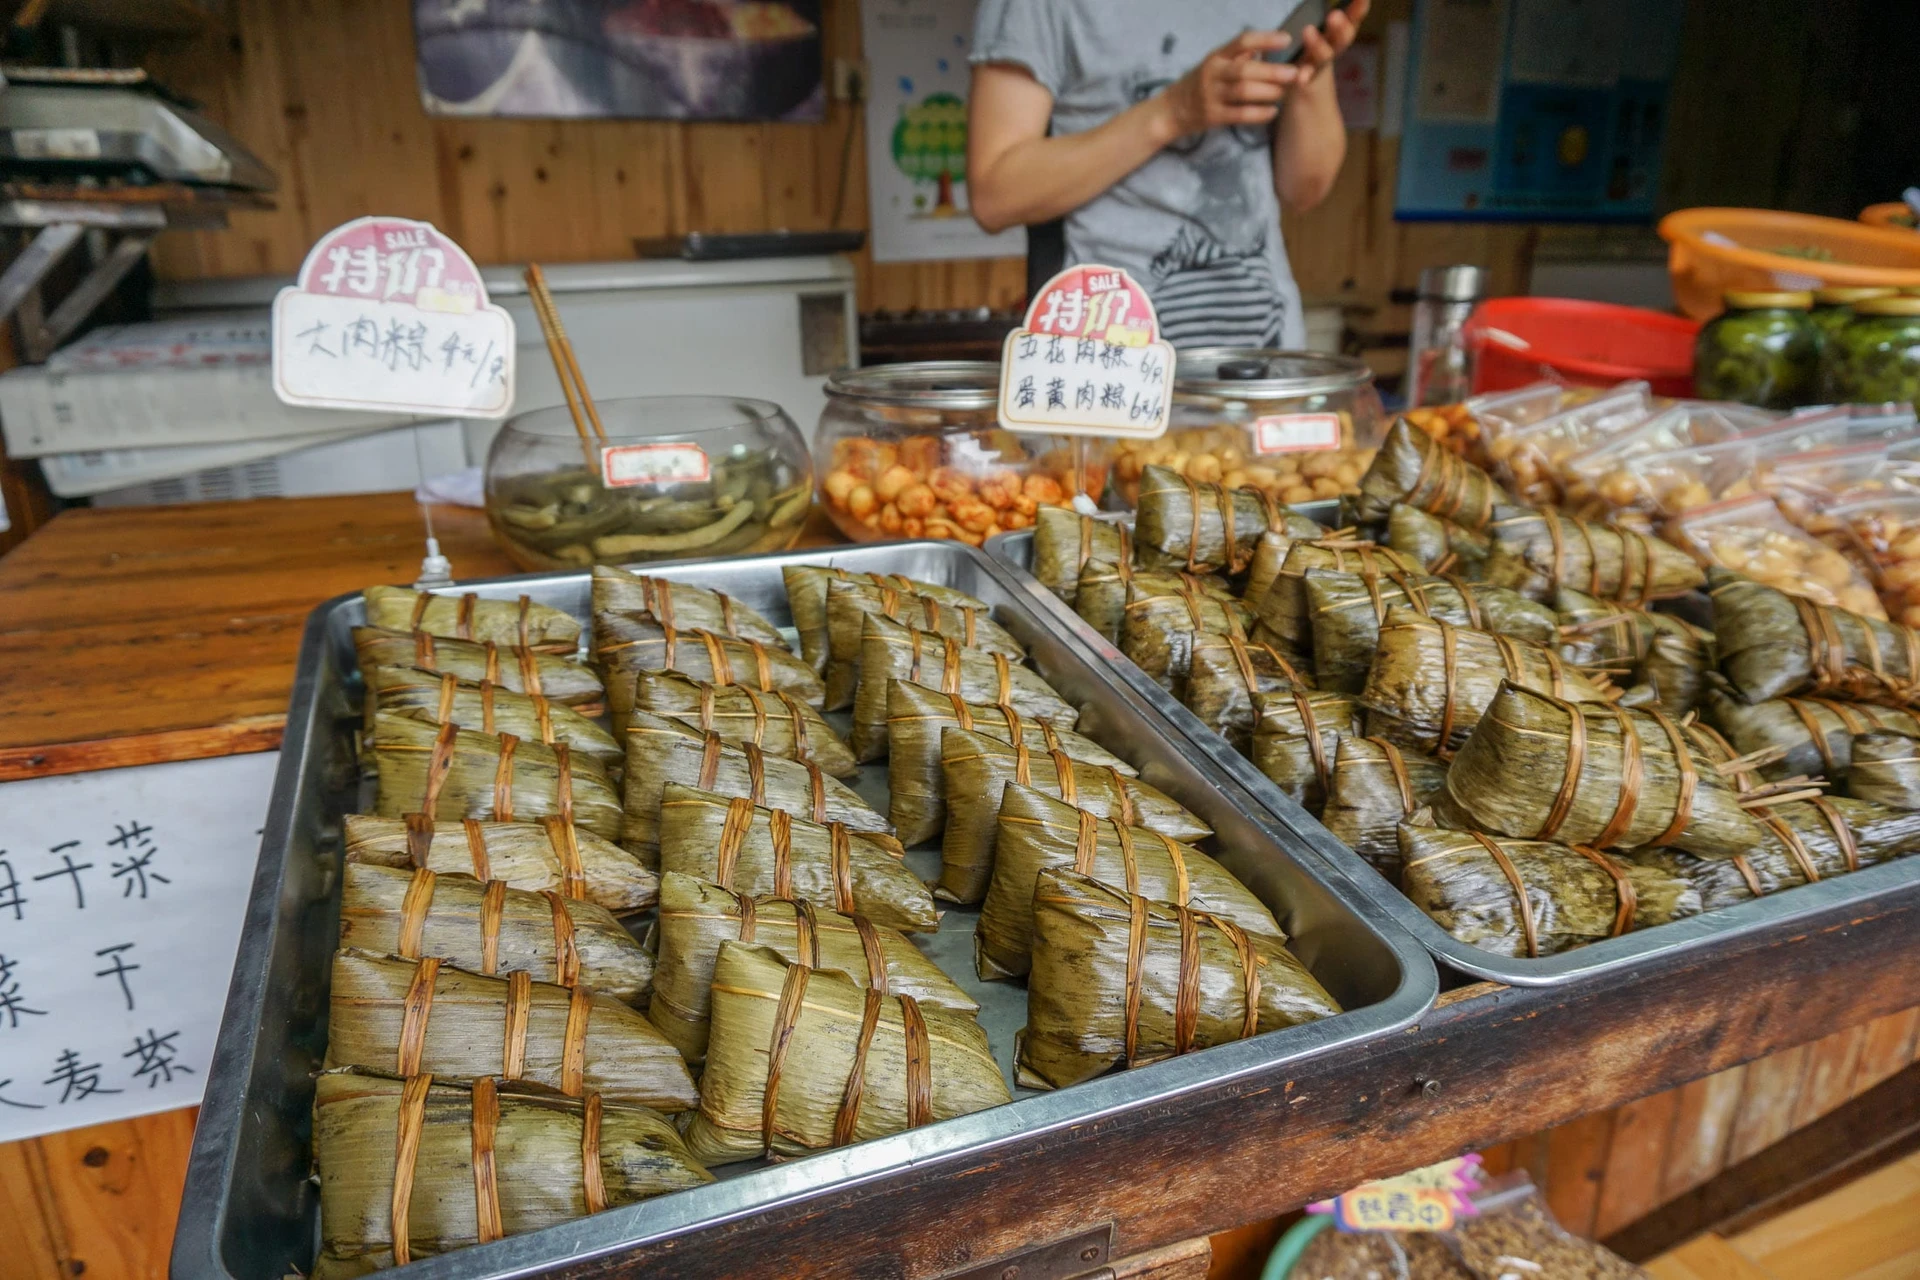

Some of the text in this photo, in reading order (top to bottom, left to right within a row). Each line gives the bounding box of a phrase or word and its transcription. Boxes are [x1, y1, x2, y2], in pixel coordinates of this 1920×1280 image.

[385, 230, 427, 249] SALE
[320, 245, 445, 300] 特价
[1089, 273, 1121, 292] SALE
[1039, 288, 1131, 336] 特价
[1014, 375, 1127, 412] 蛋黄肉粽
